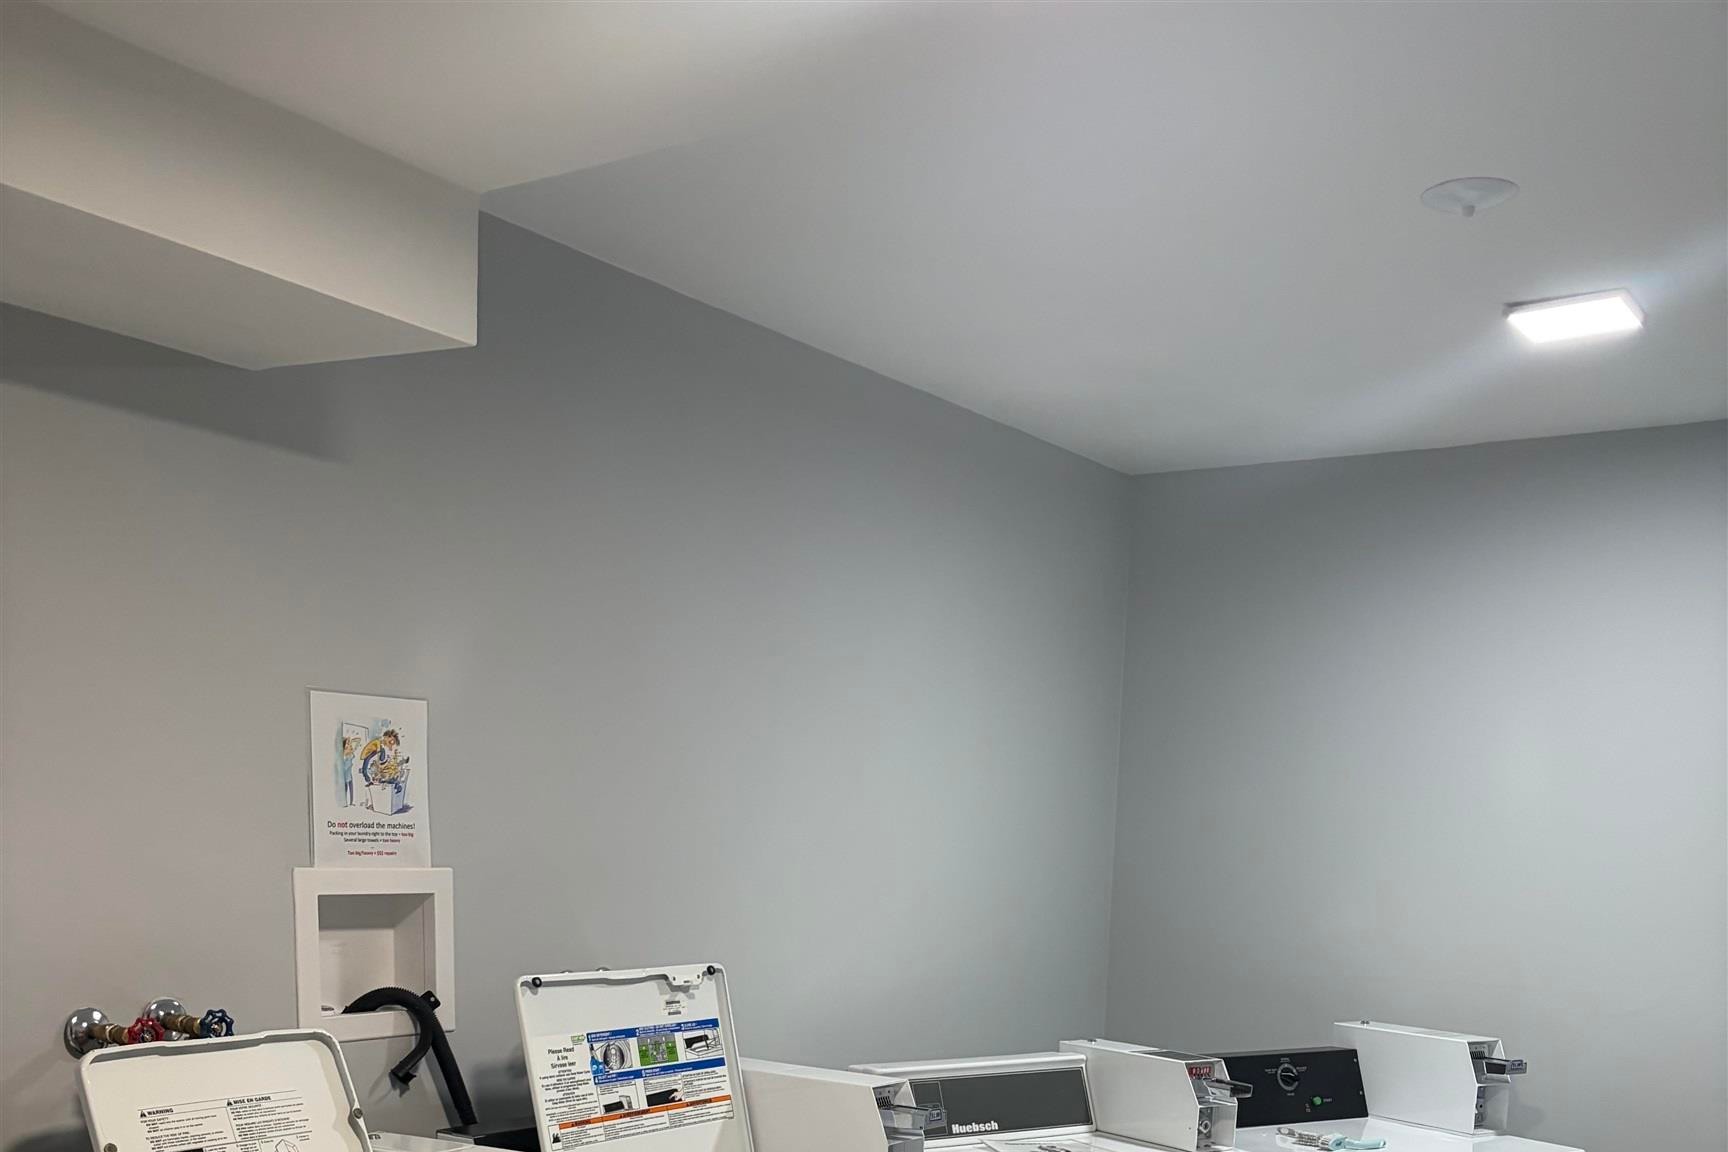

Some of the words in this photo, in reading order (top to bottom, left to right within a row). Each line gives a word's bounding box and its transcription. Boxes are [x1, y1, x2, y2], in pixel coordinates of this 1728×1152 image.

[327, 820, 336, 828] Do
[349, 821, 375, 829] overload
[387, 822, 416, 830] machines!
[147, 1107, 174, 1116] WARNING
[951, 1120, 999, 1134] Huebsch
